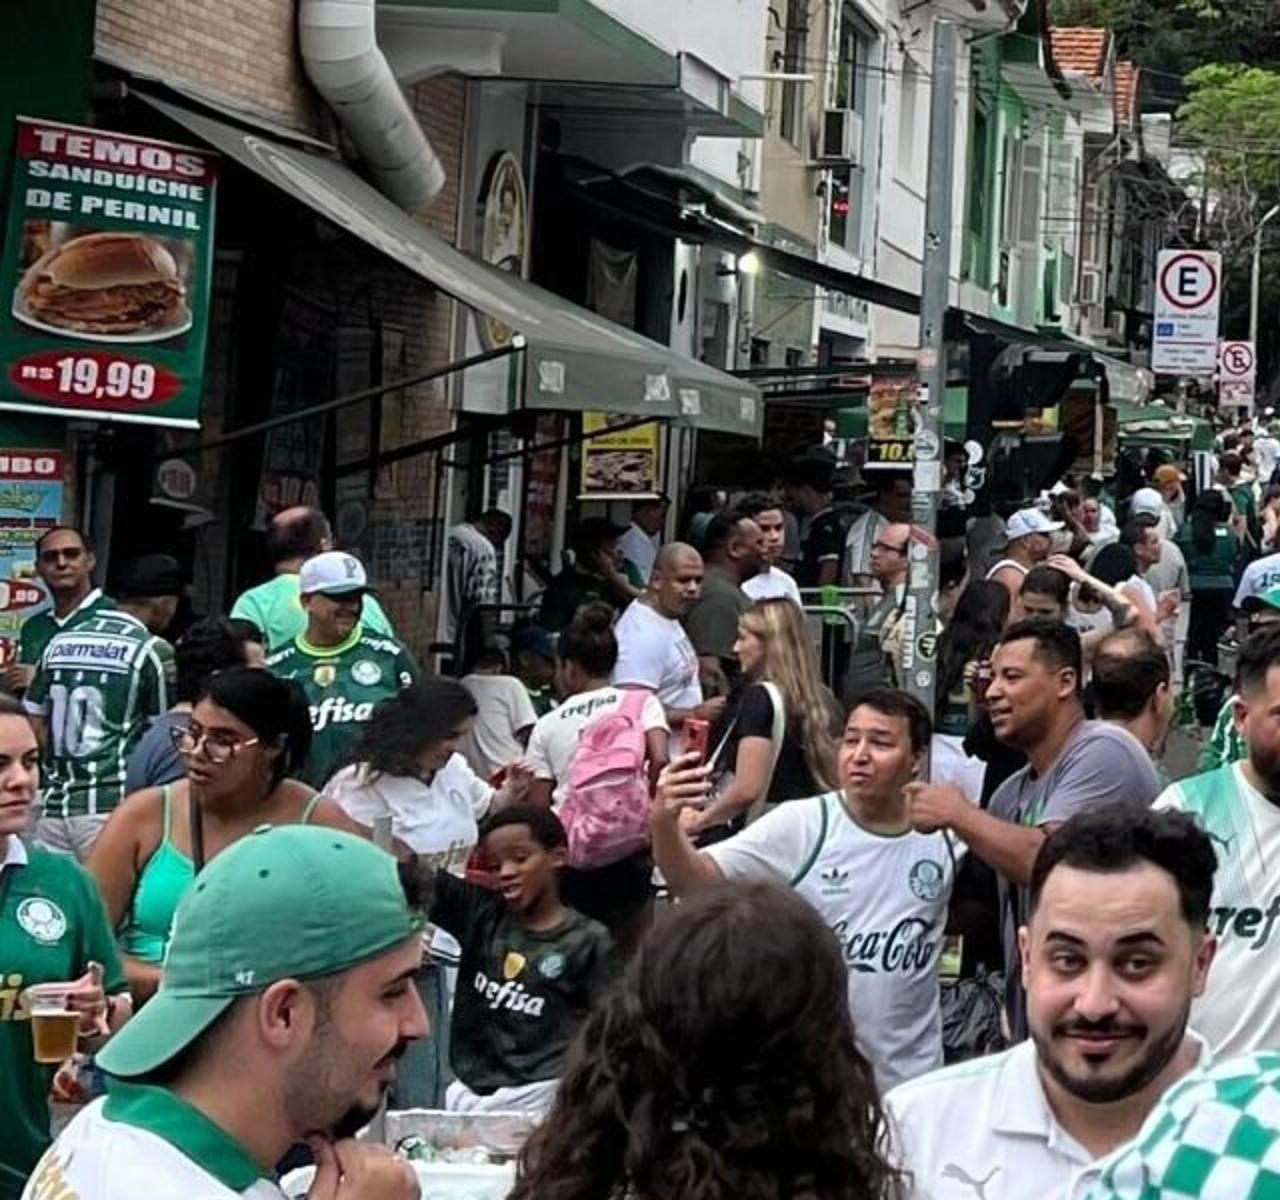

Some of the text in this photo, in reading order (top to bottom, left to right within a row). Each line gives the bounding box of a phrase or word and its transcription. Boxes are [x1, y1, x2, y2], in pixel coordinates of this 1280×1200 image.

[33, 130, 205, 177] TEMOS
[26, 188, 202, 231] DE PERNIL
[1179, 266, 1199, 296] E
[57, 357, 156, 400] 19,99
[49, 643, 129, 662] parmalat
[50, 683, 106, 758] 10
